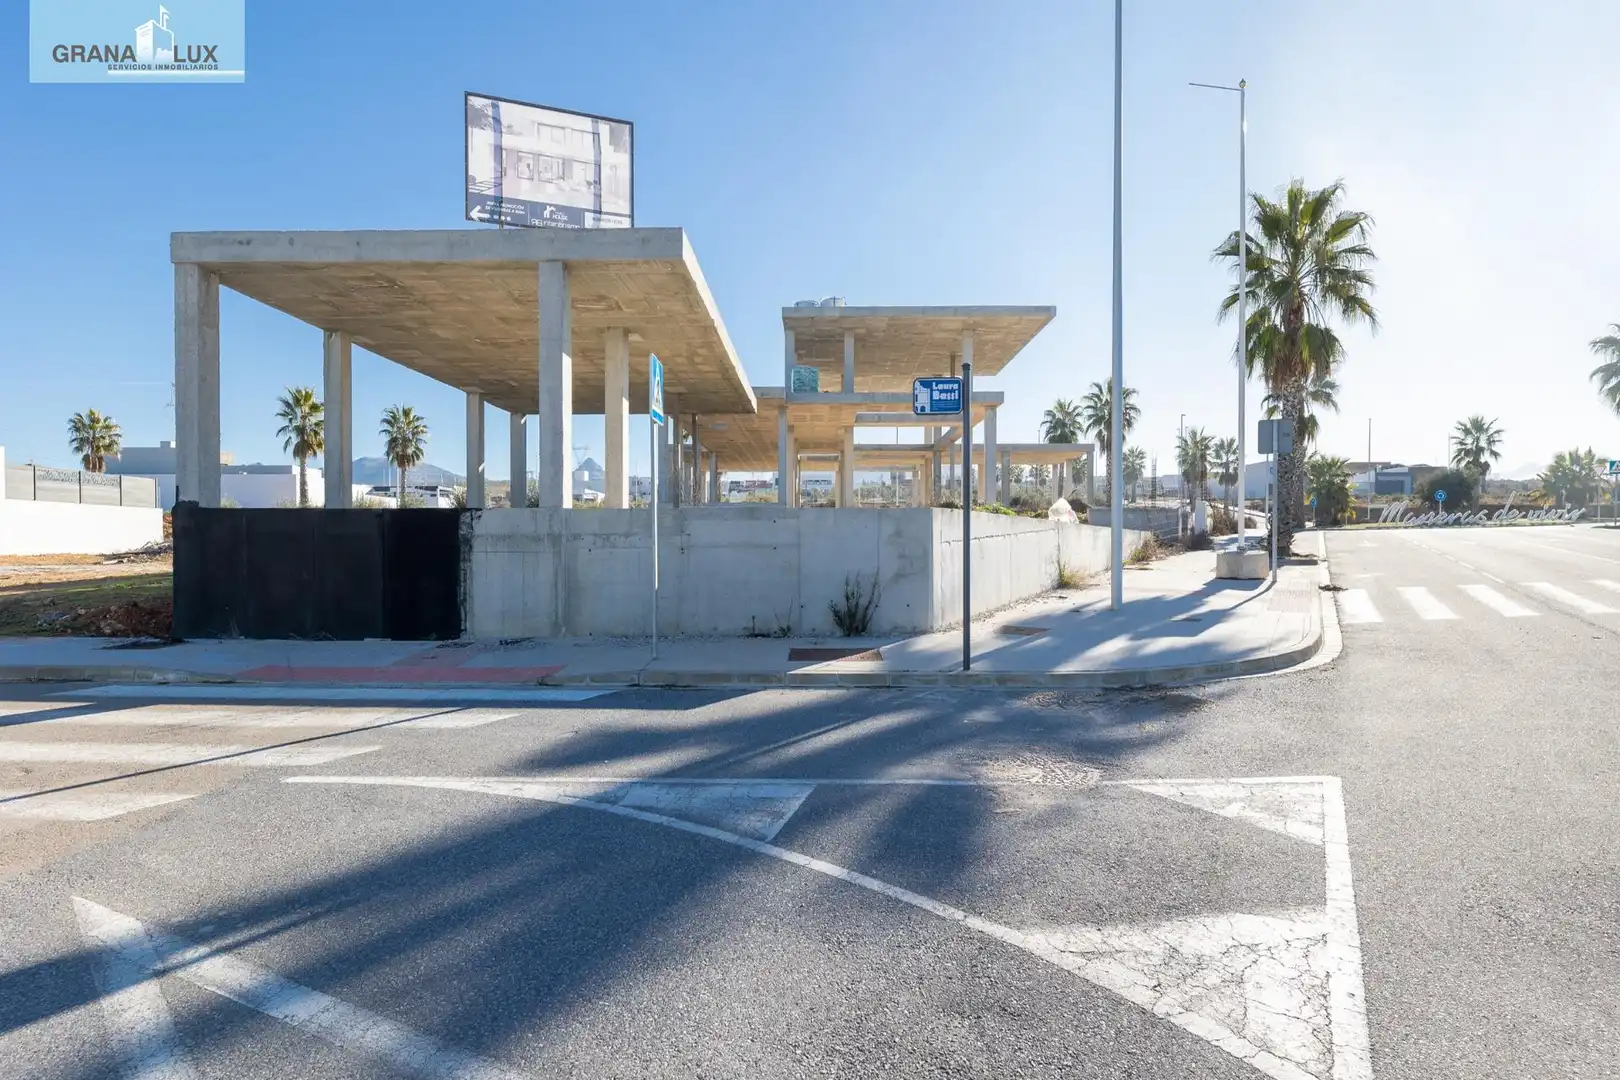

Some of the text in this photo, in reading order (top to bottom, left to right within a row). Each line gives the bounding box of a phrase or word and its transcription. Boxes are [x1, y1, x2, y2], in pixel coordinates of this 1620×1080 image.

[932, 382, 958, 390] Laura
[932, 390, 958, 400] Bassi
[1491, 490, 1526, 522] de
